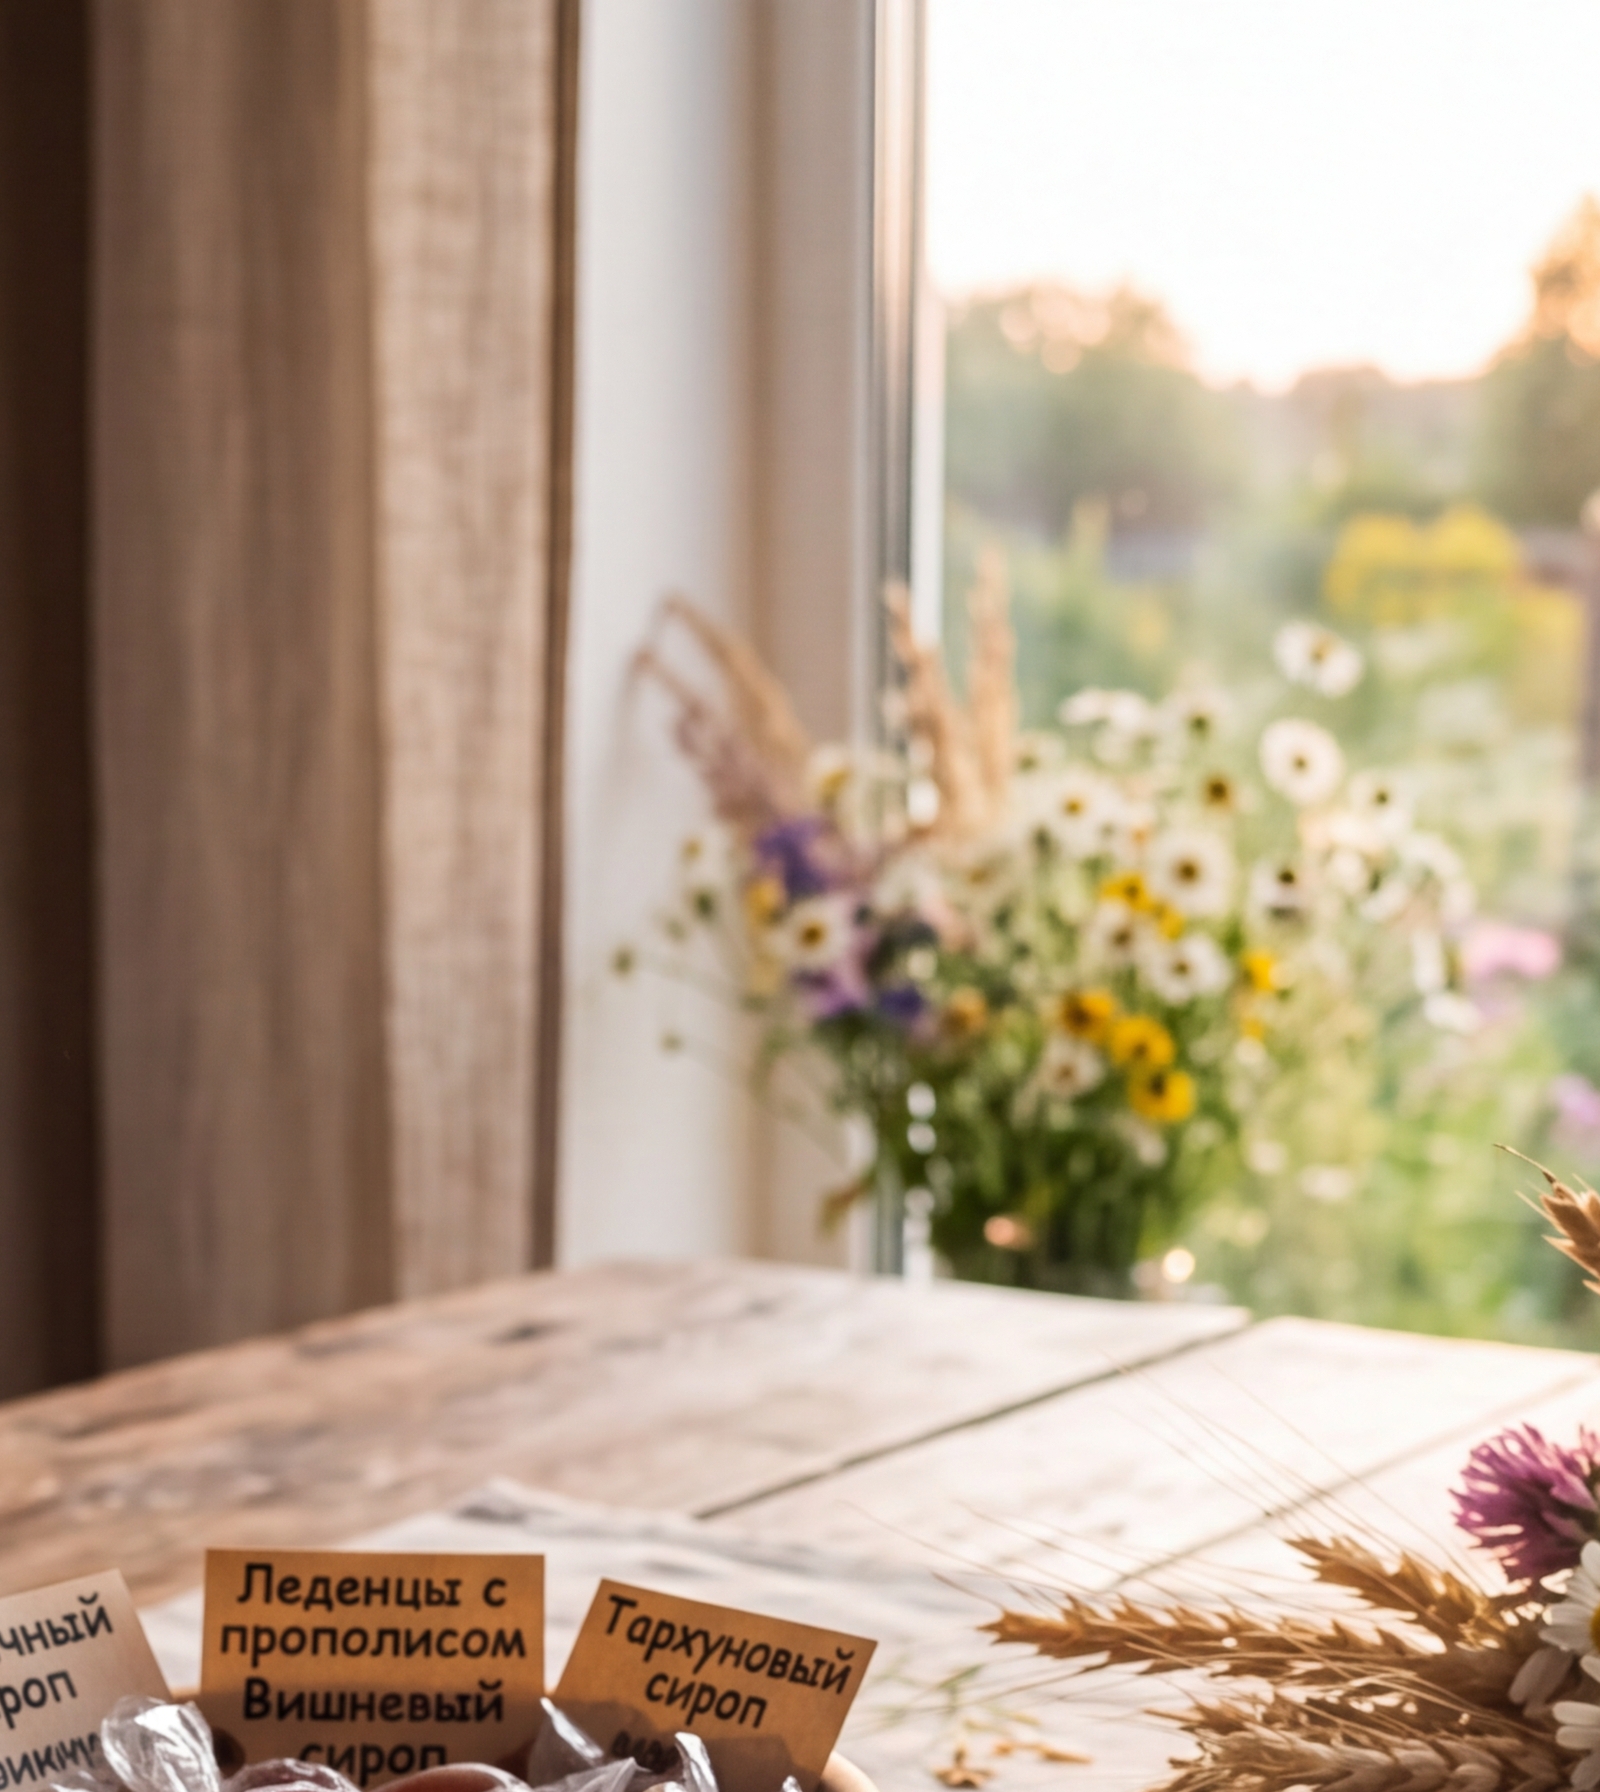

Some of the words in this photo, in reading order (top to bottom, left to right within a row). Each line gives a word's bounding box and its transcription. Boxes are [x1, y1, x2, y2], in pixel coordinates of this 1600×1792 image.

[236, 1562, 462, 1612] Леденцы
[482, 1577, 507, 1608] с
[220, 1624, 527, 1669] прополисом
[605, 1594, 855, 1696] Тархуновый
[242, 1677, 505, 1723] Вишневый
[644, 1672, 768, 1730] сироп
